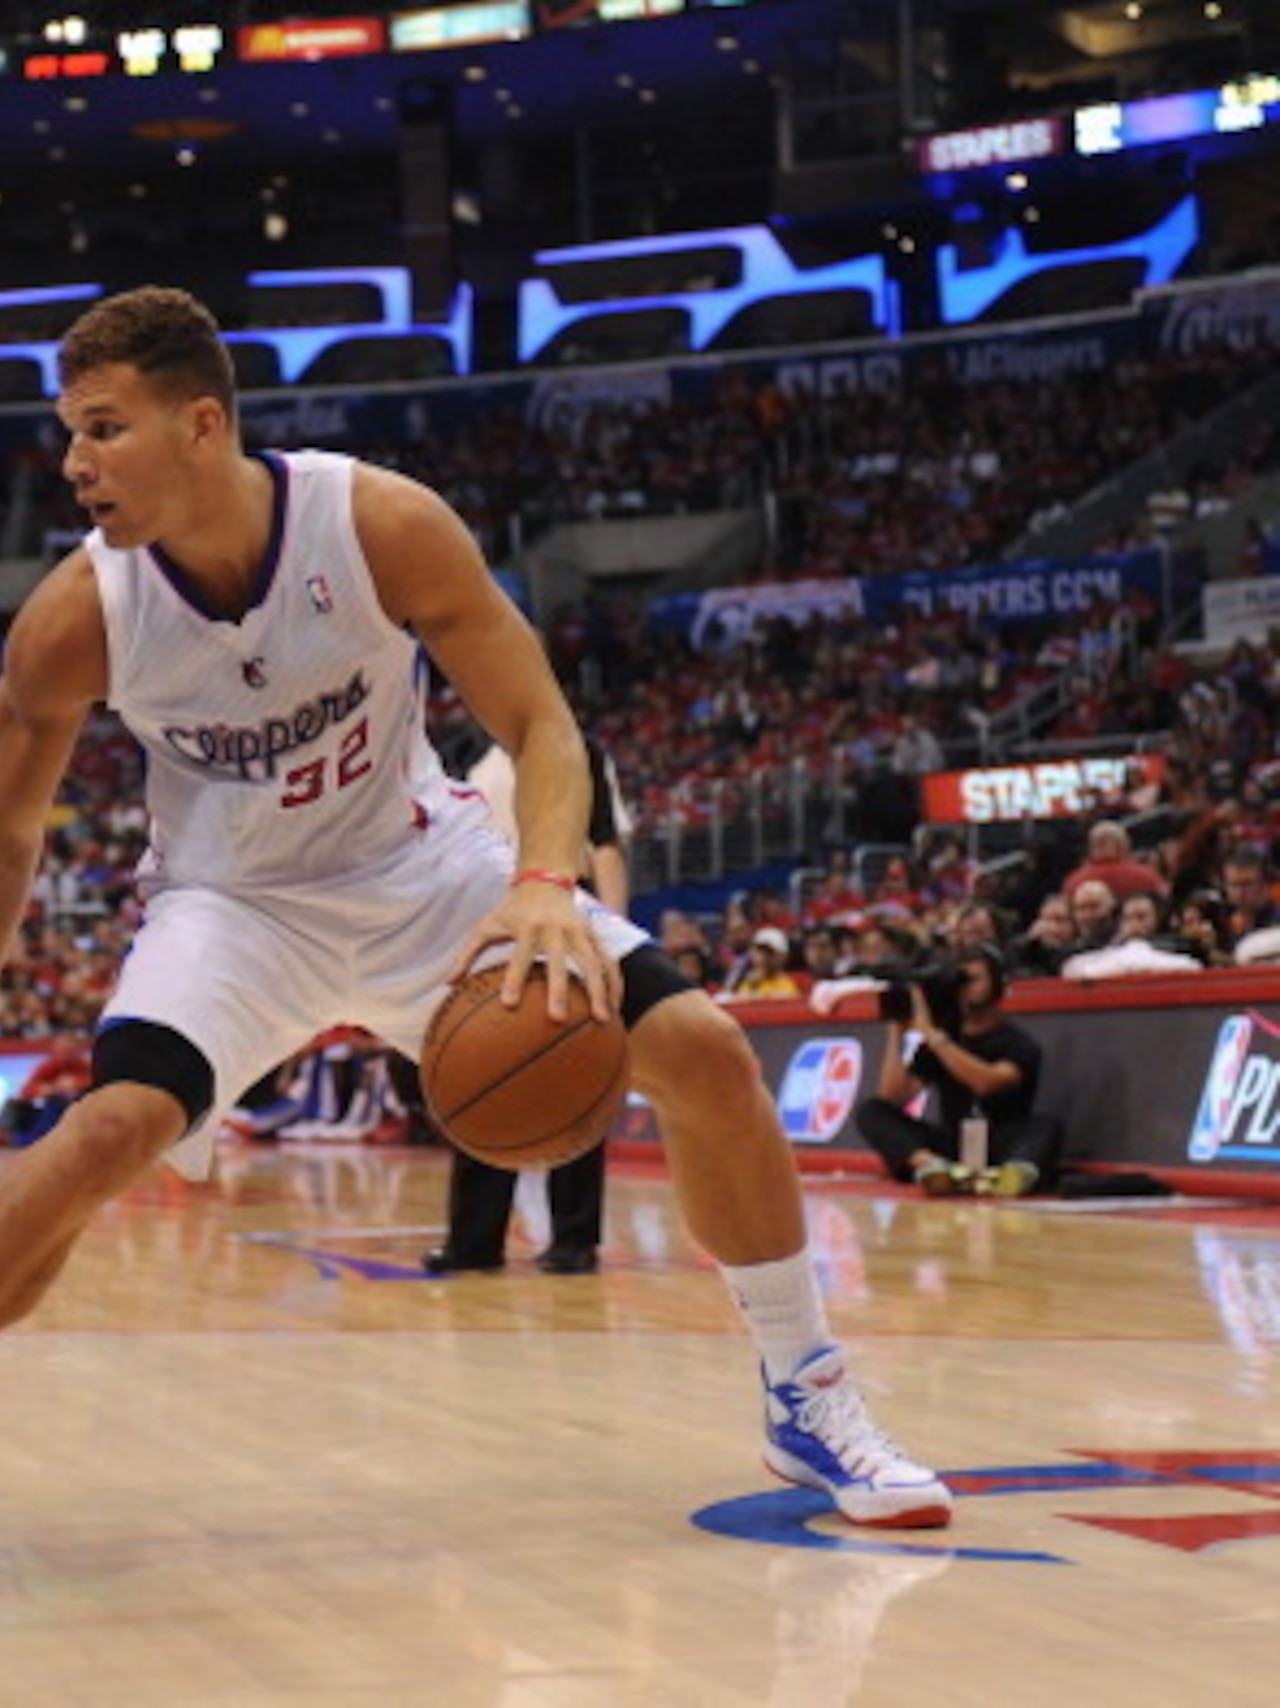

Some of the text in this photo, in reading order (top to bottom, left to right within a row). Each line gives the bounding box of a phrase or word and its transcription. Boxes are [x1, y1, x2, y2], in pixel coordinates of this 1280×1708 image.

[928, 119, 1053, 170] STAPLES
[163, 668, 370, 780] Clippers
[282, 717, 371, 807] 32
